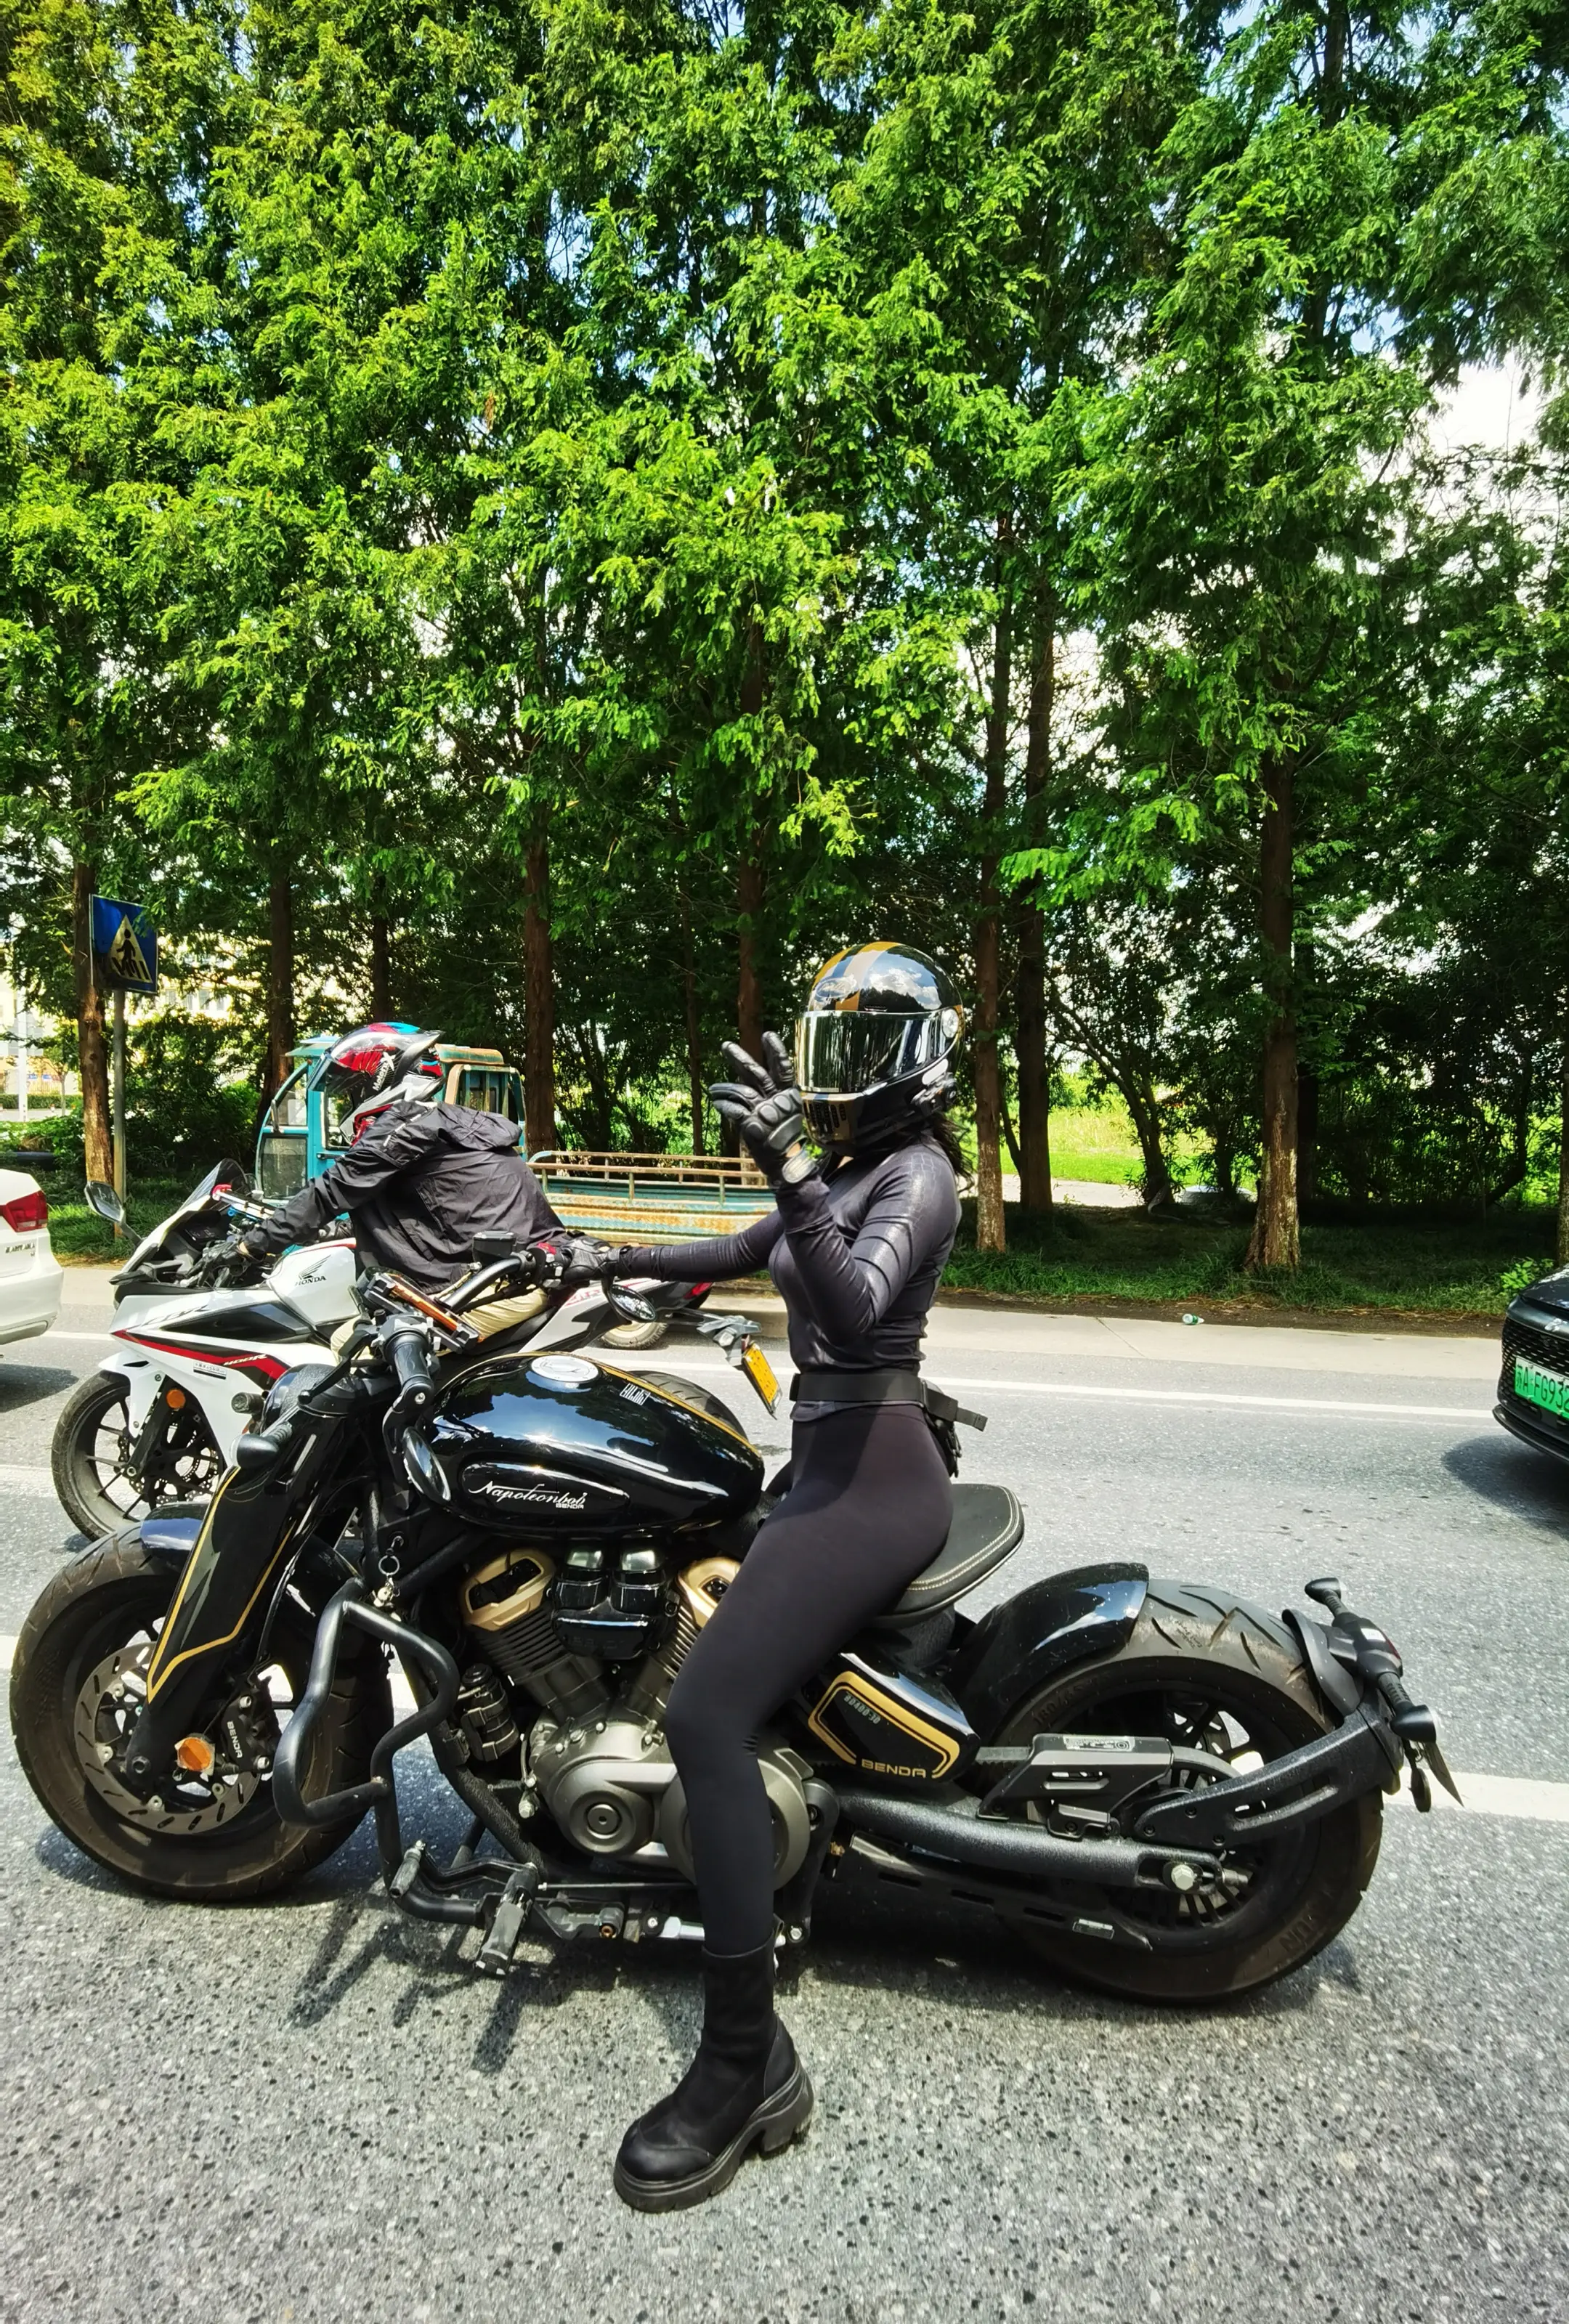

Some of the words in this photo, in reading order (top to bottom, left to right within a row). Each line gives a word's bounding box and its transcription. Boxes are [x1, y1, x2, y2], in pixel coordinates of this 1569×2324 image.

[295, 1275, 327, 1285] HONDA
[227, 1720, 243, 1758] BENDA
[861, 1758, 927, 1779] BENDA
